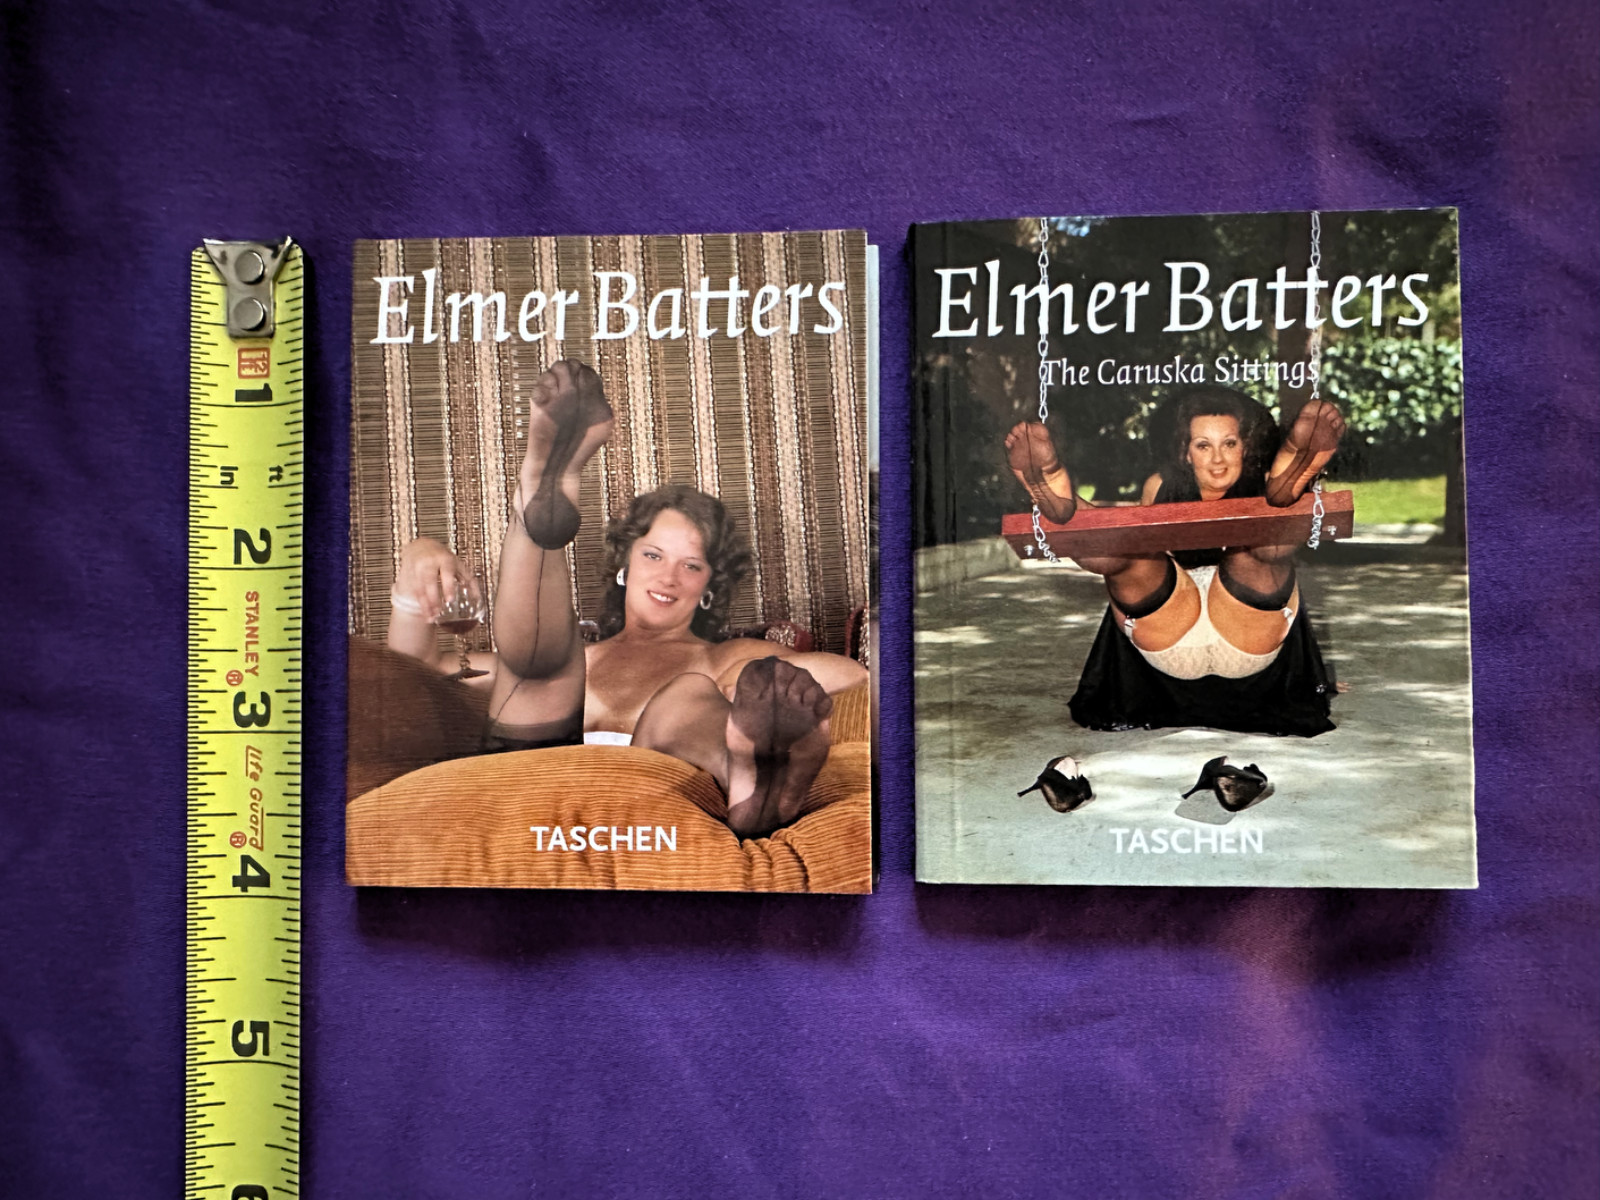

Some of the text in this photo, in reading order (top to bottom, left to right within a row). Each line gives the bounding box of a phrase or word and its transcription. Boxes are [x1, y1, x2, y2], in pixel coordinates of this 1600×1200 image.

[370, 267, 846, 345] Elmer Batters
[932, 259, 1431, 338] Elmer Batters
[1042, 355, 1319, 389] The Caruska Sittings
[235, 383, 273, 402] 1
[268, 465, 284, 482] ft
[233, 528, 272, 565] 2
[244, 590, 260, 677] STANLEY
[232, 691, 271, 728] 3
[248, 787, 264, 851] Guard
[529, 825, 678, 852] TASCHEN
[1108, 827, 1264, 854] TASCHEN
[231, 854, 271, 893] 4
[231, 1019, 270, 1057] 5
